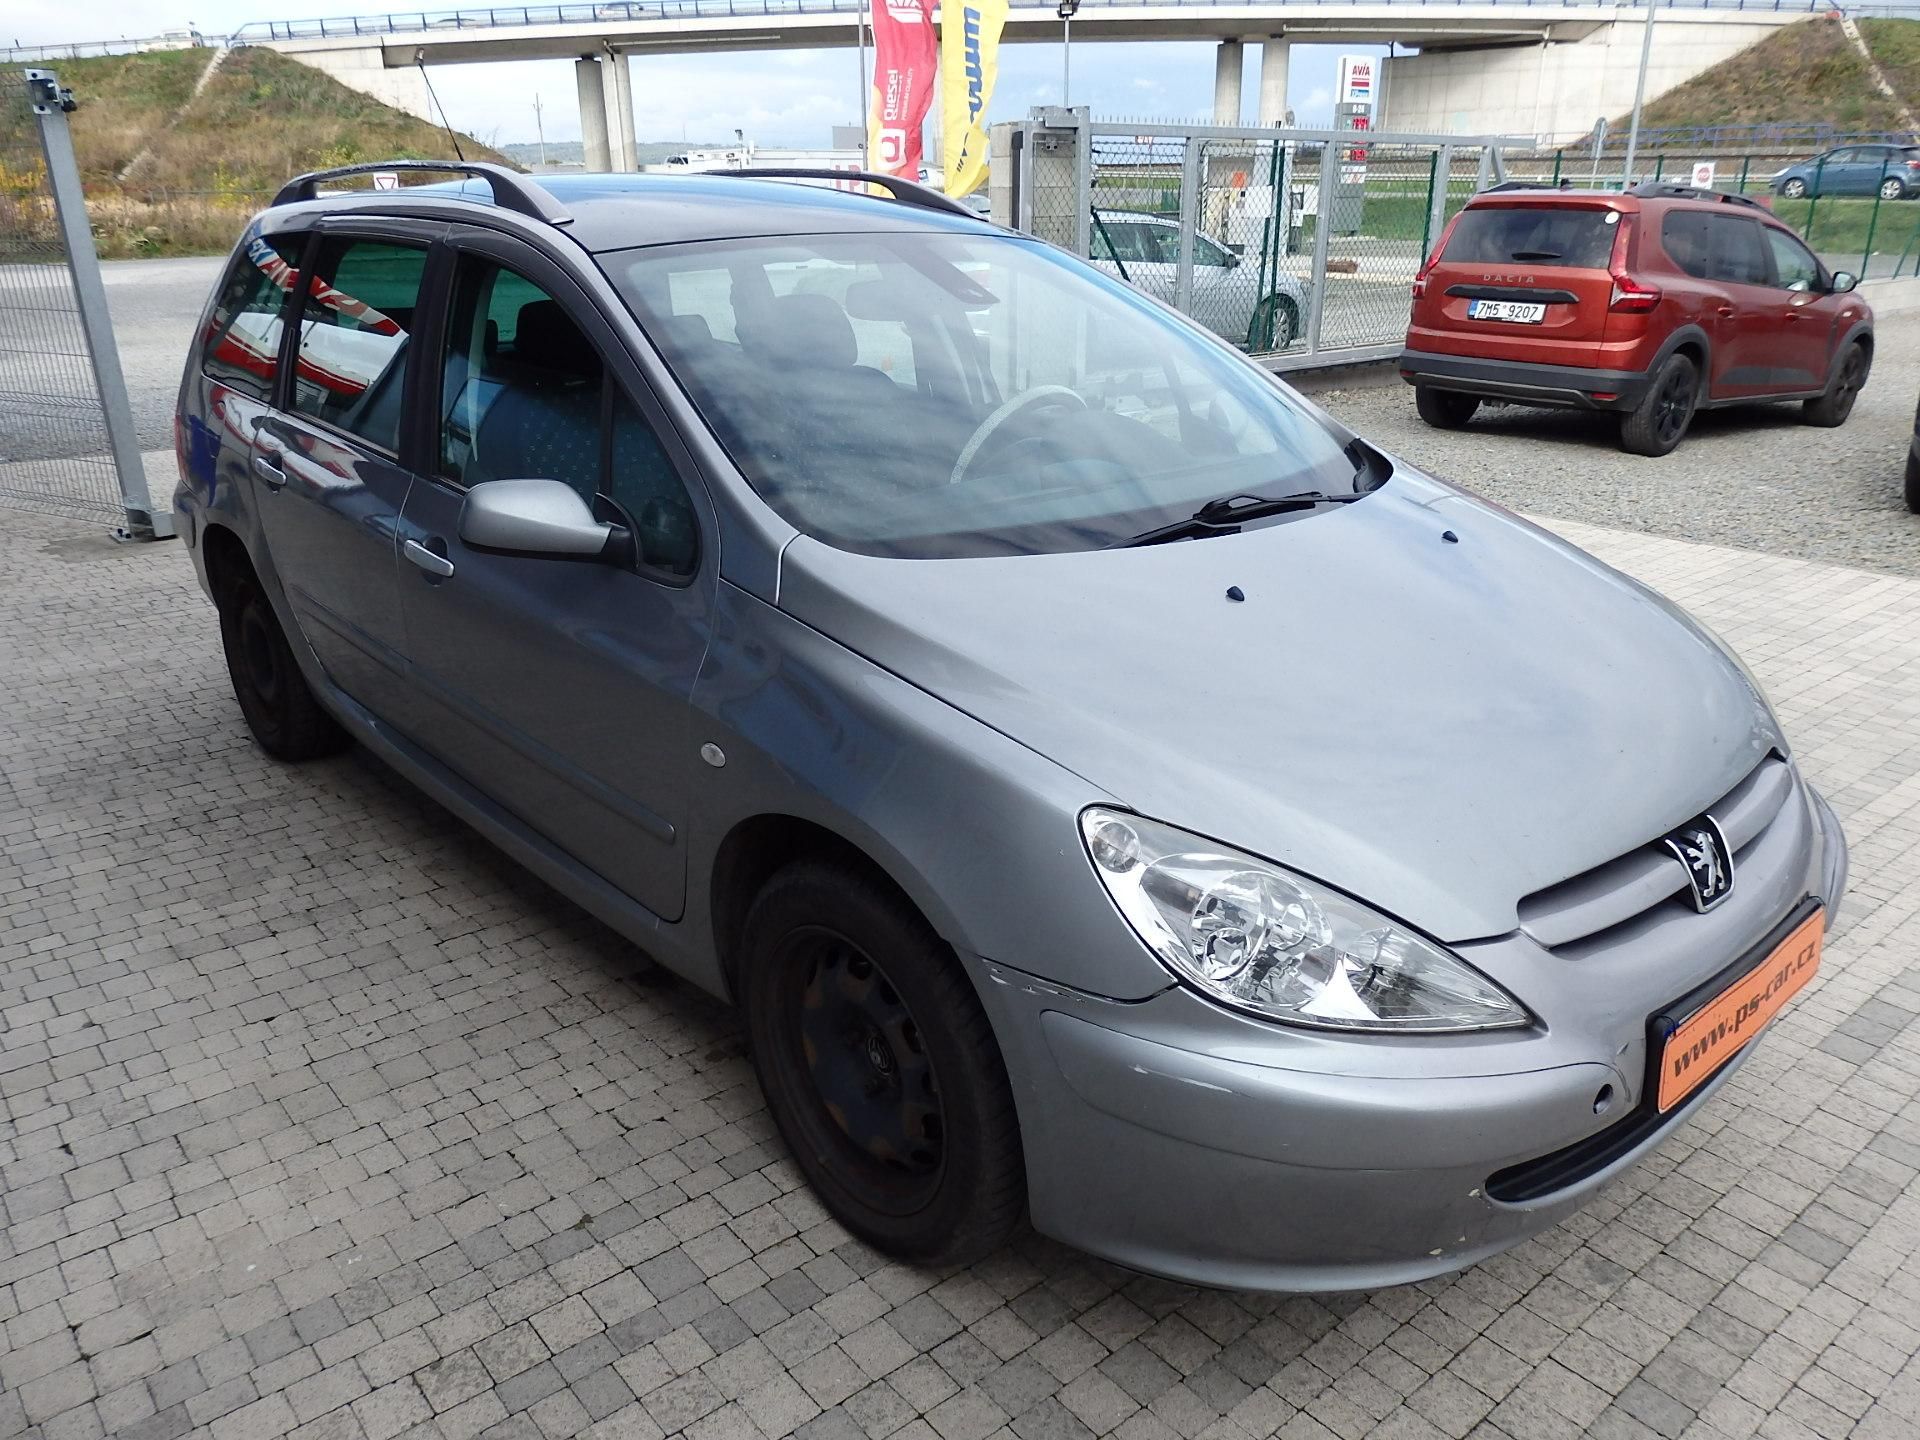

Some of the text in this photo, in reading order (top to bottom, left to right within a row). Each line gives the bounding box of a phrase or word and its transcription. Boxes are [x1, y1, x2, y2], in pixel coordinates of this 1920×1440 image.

[1352, 64, 1370, 77] AVIA
[1483, 274, 1535, 283] DACIA
[1478, 303, 1538, 319] 7M5 9207
[1674, 941, 1816, 1078] www.ps-car.cz
